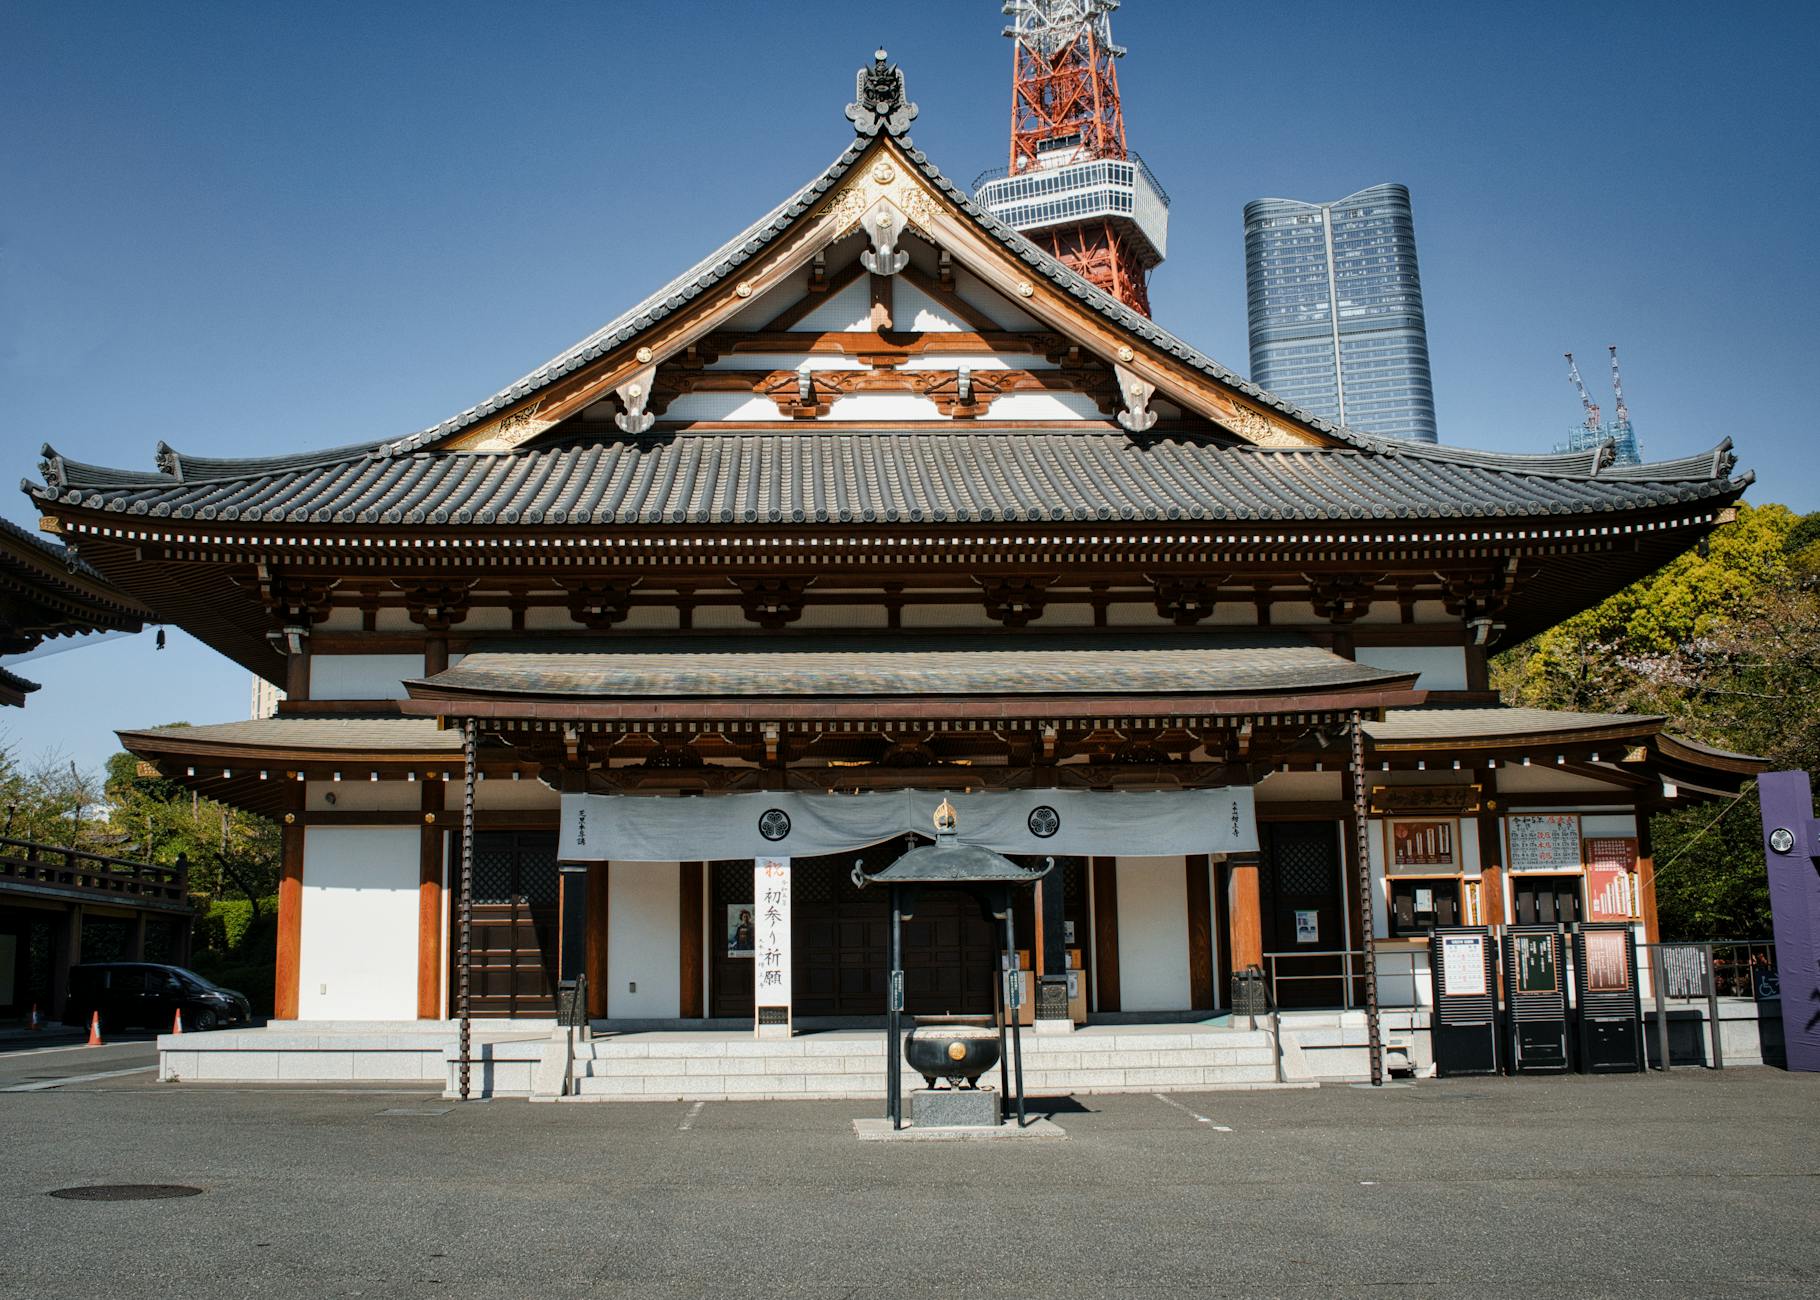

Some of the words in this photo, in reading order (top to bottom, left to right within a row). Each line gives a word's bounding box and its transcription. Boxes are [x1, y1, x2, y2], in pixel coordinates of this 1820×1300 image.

[764, 861, 784, 878] 祝
[764, 887, 782, 986] 初参り祈願
